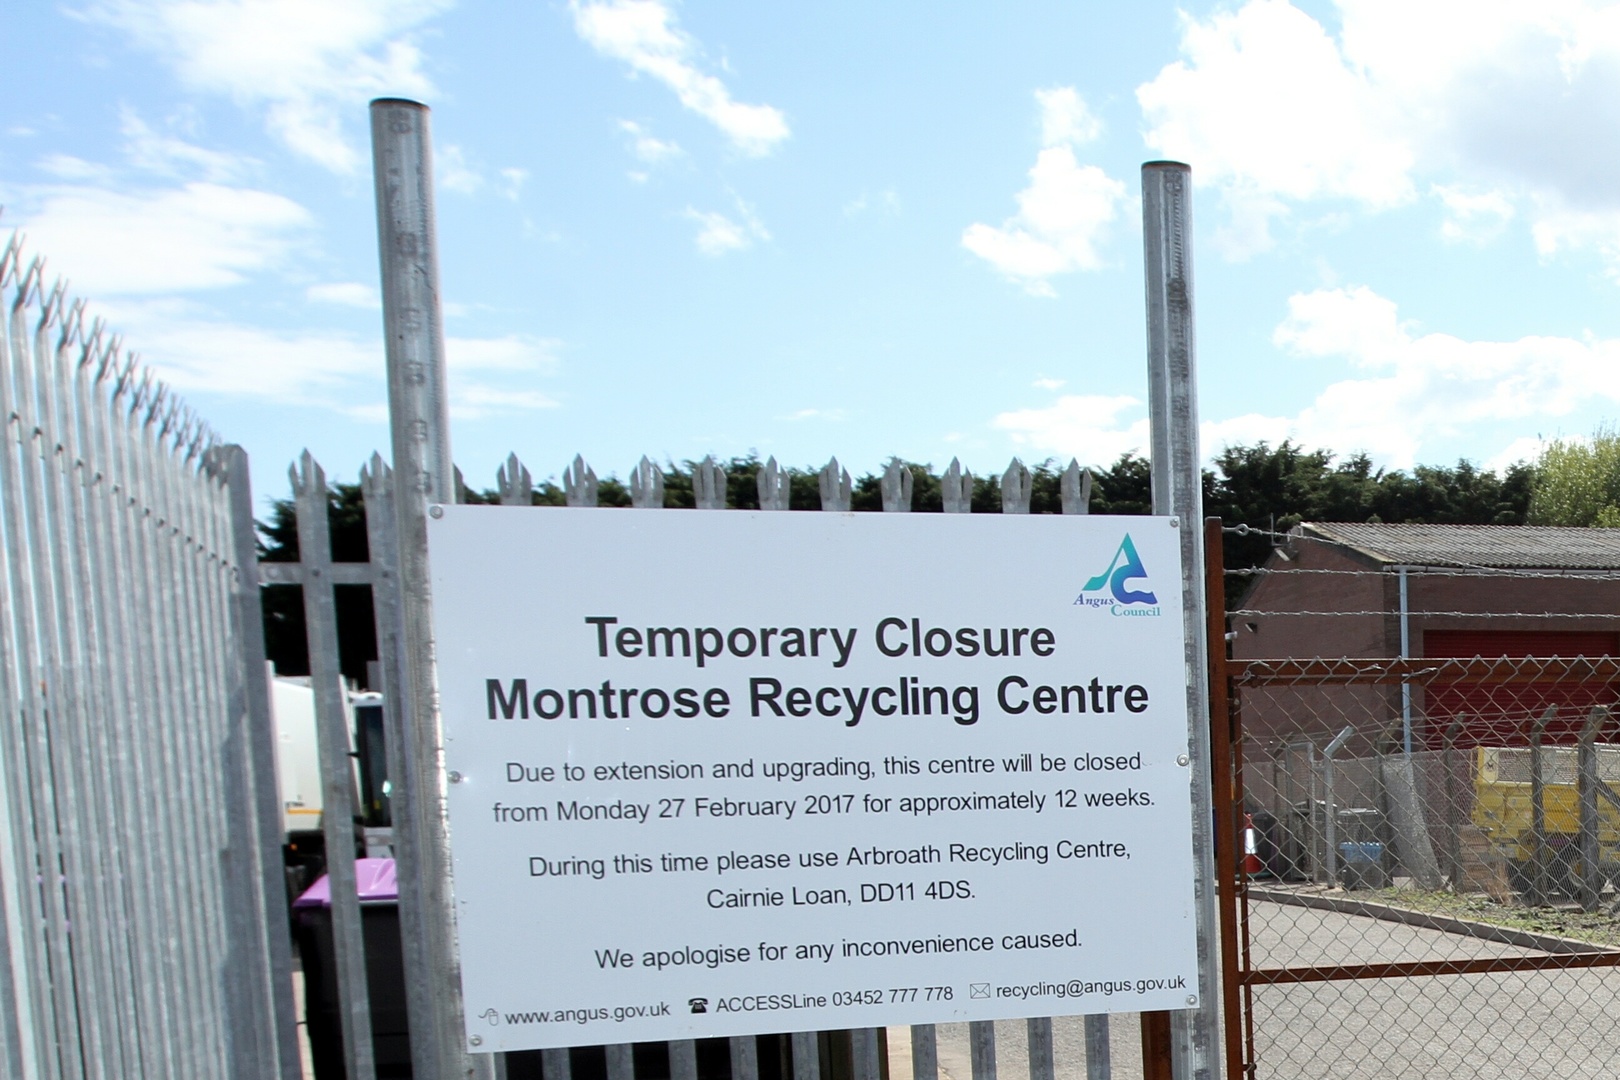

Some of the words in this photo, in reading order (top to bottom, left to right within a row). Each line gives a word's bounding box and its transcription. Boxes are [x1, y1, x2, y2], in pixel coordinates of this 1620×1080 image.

[1072, 592, 1115, 608] Angus
[1110, 604, 1161, 616] Council
[585, 617, 857, 668] Temporary
[876, 617, 1055, 657] Closure
[486, 679, 730, 720] Montrose
[750, 677, 979, 726] Recycling
[997, 675, 1148, 715] Centre
[507, 763, 555, 782] Due
[563, 763, 585, 781] to
[594, 760, 703, 781] extension
[712, 758, 754, 778] and
[763, 757, 875, 782] upgrading,
[884, 756, 920, 775] this
[928, 756, 995, 774] centre
[1002, 753, 1032, 772] will
[1040, 753, 1066, 772] be
[1074, 752, 1141, 771] closed
[493, 802, 548, 822] from
[557, 800, 650, 824] Monday
[658, 798, 685, 818] 27
[695, 797, 796, 820] February
[804, 794, 855, 814] 2017
[863, 794, 892, 813] for
[900, 790, 1046, 816] approximately
[1055, 789, 1077, 808] 12
[1084, 788, 1154, 807] weeks.
[530, 856, 605, 880] During
[613, 854, 653, 874] this
[661, 853, 708, 872] time
[717, 851, 790, 875] please
[799, 852, 838, 868] use
[846, 845, 941, 866] Arbroath
[950, 842, 1048, 866] Recycling
[1057, 840, 1130, 859] Centre,
[707, 888, 784, 909] Cairnie
[792, 887, 851, 906] Loan,
[861, 882, 914, 902] DD11
[925, 880, 975, 900] 4DS.
[595, 949, 634, 969] We
[643, 944, 750, 971] apologise
[758, 942, 788, 961] for
[796, 944, 834, 963] any
[842, 934, 994, 957] inconvenience
[1002, 929, 1082, 950] caused.
[505, 1001, 670, 1025] www.angus.gov.uk
[716, 994, 827, 1013] ACCESSLine
[832, 990, 883, 1006] 03452
[889, 988, 918, 1003] 777
[924, 986, 954, 1001] 778
[997, 975, 1186, 1000] recycling@angus.gov.uk
